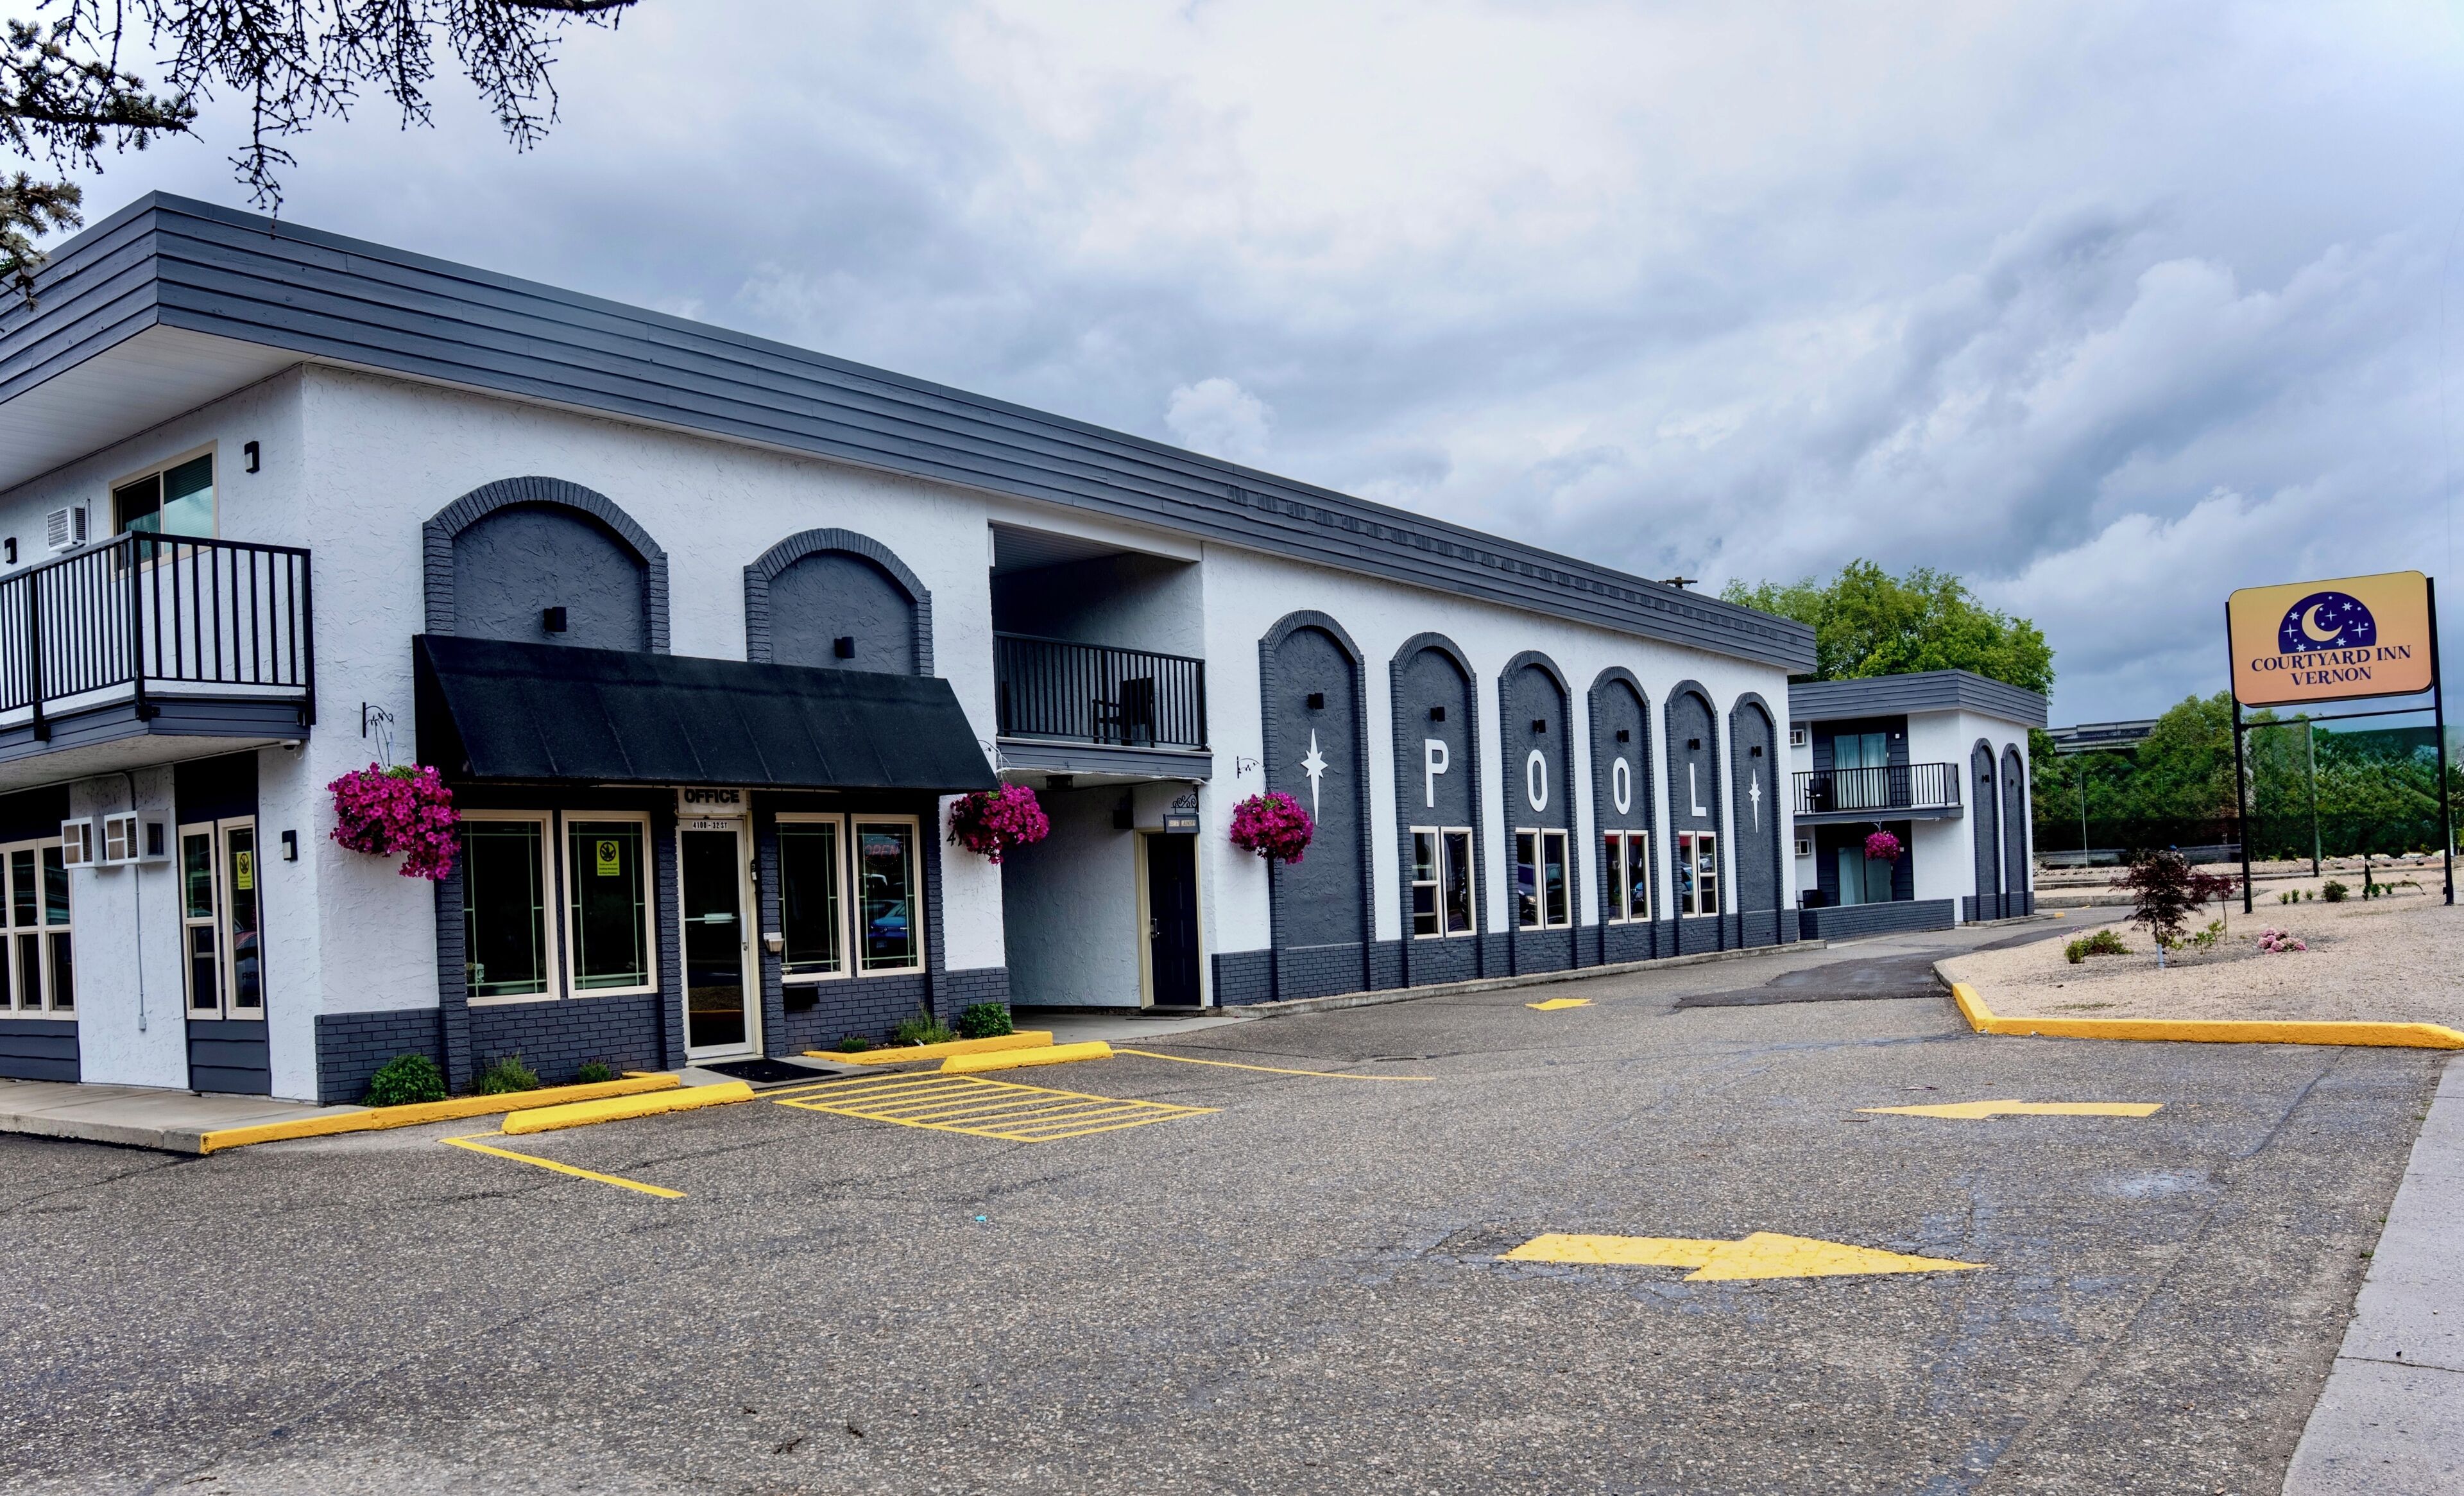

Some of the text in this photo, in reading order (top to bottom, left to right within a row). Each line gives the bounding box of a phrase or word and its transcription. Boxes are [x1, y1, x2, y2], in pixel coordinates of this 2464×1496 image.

[2251, 645, 2411, 672] COURTYARD INN
[2291, 667, 2372, 685] VERNON
[684, 789, 740, 804] OFFICE
[864, 845, 899, 859] OPEN
